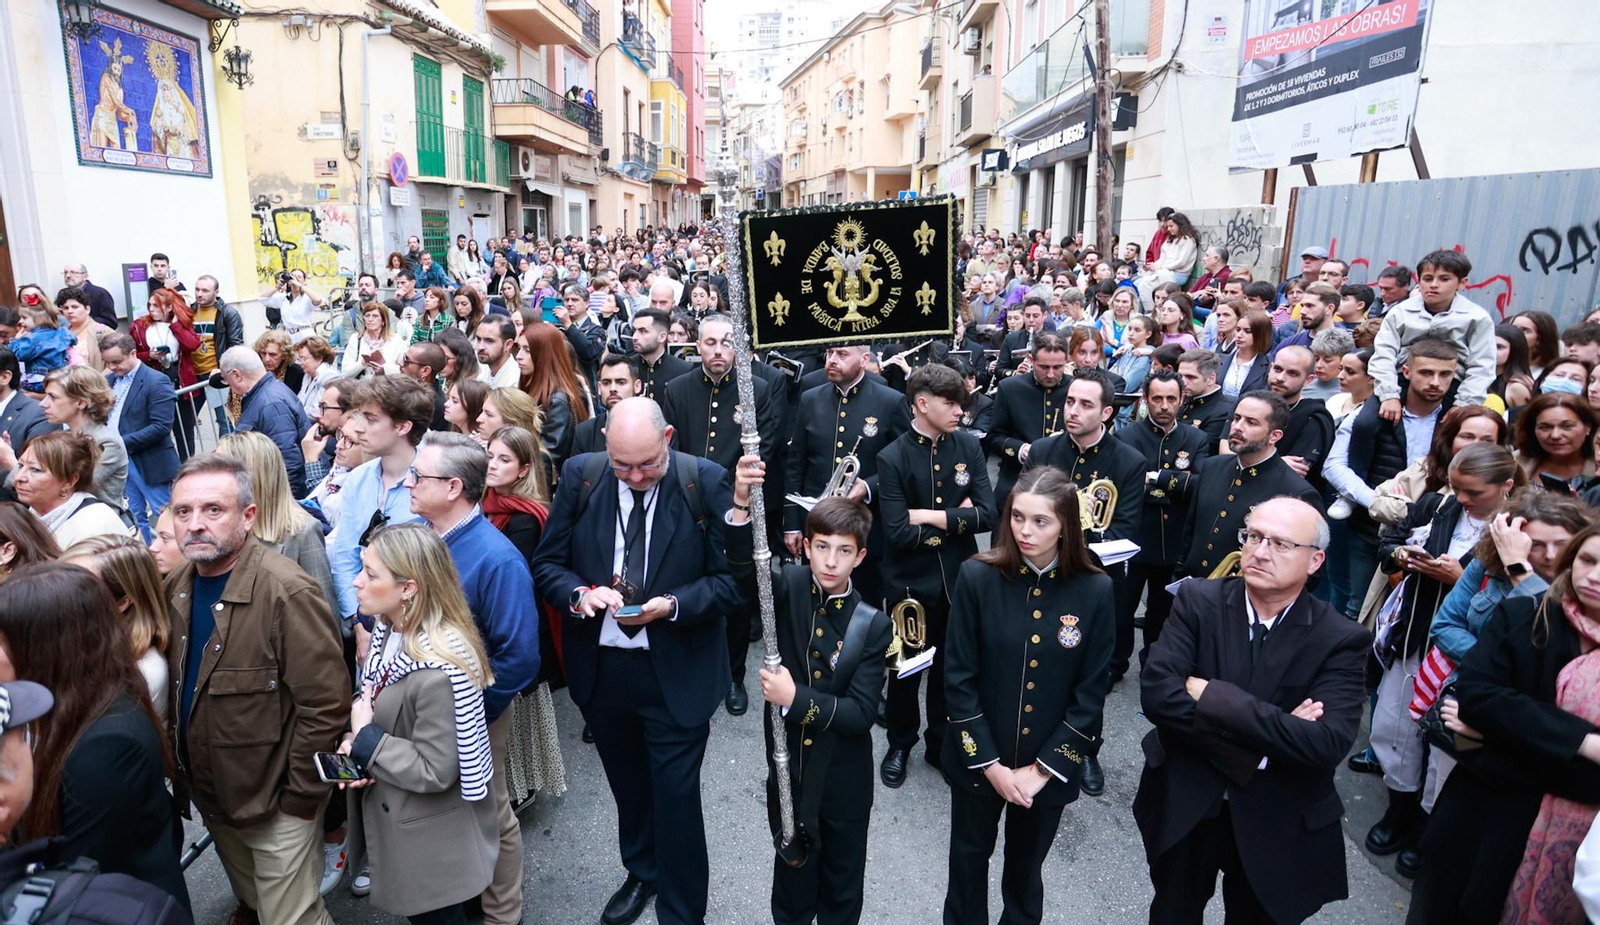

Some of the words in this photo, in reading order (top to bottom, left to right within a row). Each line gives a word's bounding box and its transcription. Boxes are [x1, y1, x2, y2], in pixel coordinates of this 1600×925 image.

[1251, 25, 1321, 55] ¡EMPEZAMOS
[1324, 19, 1347, 39] LAS
[1351, 4, 1407, 33] OBRAS!
[1244, 103, 1251, 111] DE
[1268, 87, 1306, 104] DORMITORIOS,
[1306, 79, 1327, 93] ÁTICOS
[1328, 77, 1333, 86] Y
[1334, 69, 1360, 85] DUPLEX
[1246, 83, 1277, 101] PROMOCIÓN
[1278, 81, 1286, 91] DE
[1287, 78, 1293, 87] 18
[1294, 67, 1326, 85] VIVIENDAS
[802, 240, 830, 274] BANDA
[872, 239, 903, 280] SOLEDAD
[801, 279, 813, 294] DE
[807, 301, 842, 332] MÚSICA
[851, 315, 882, 333] NTRA.
